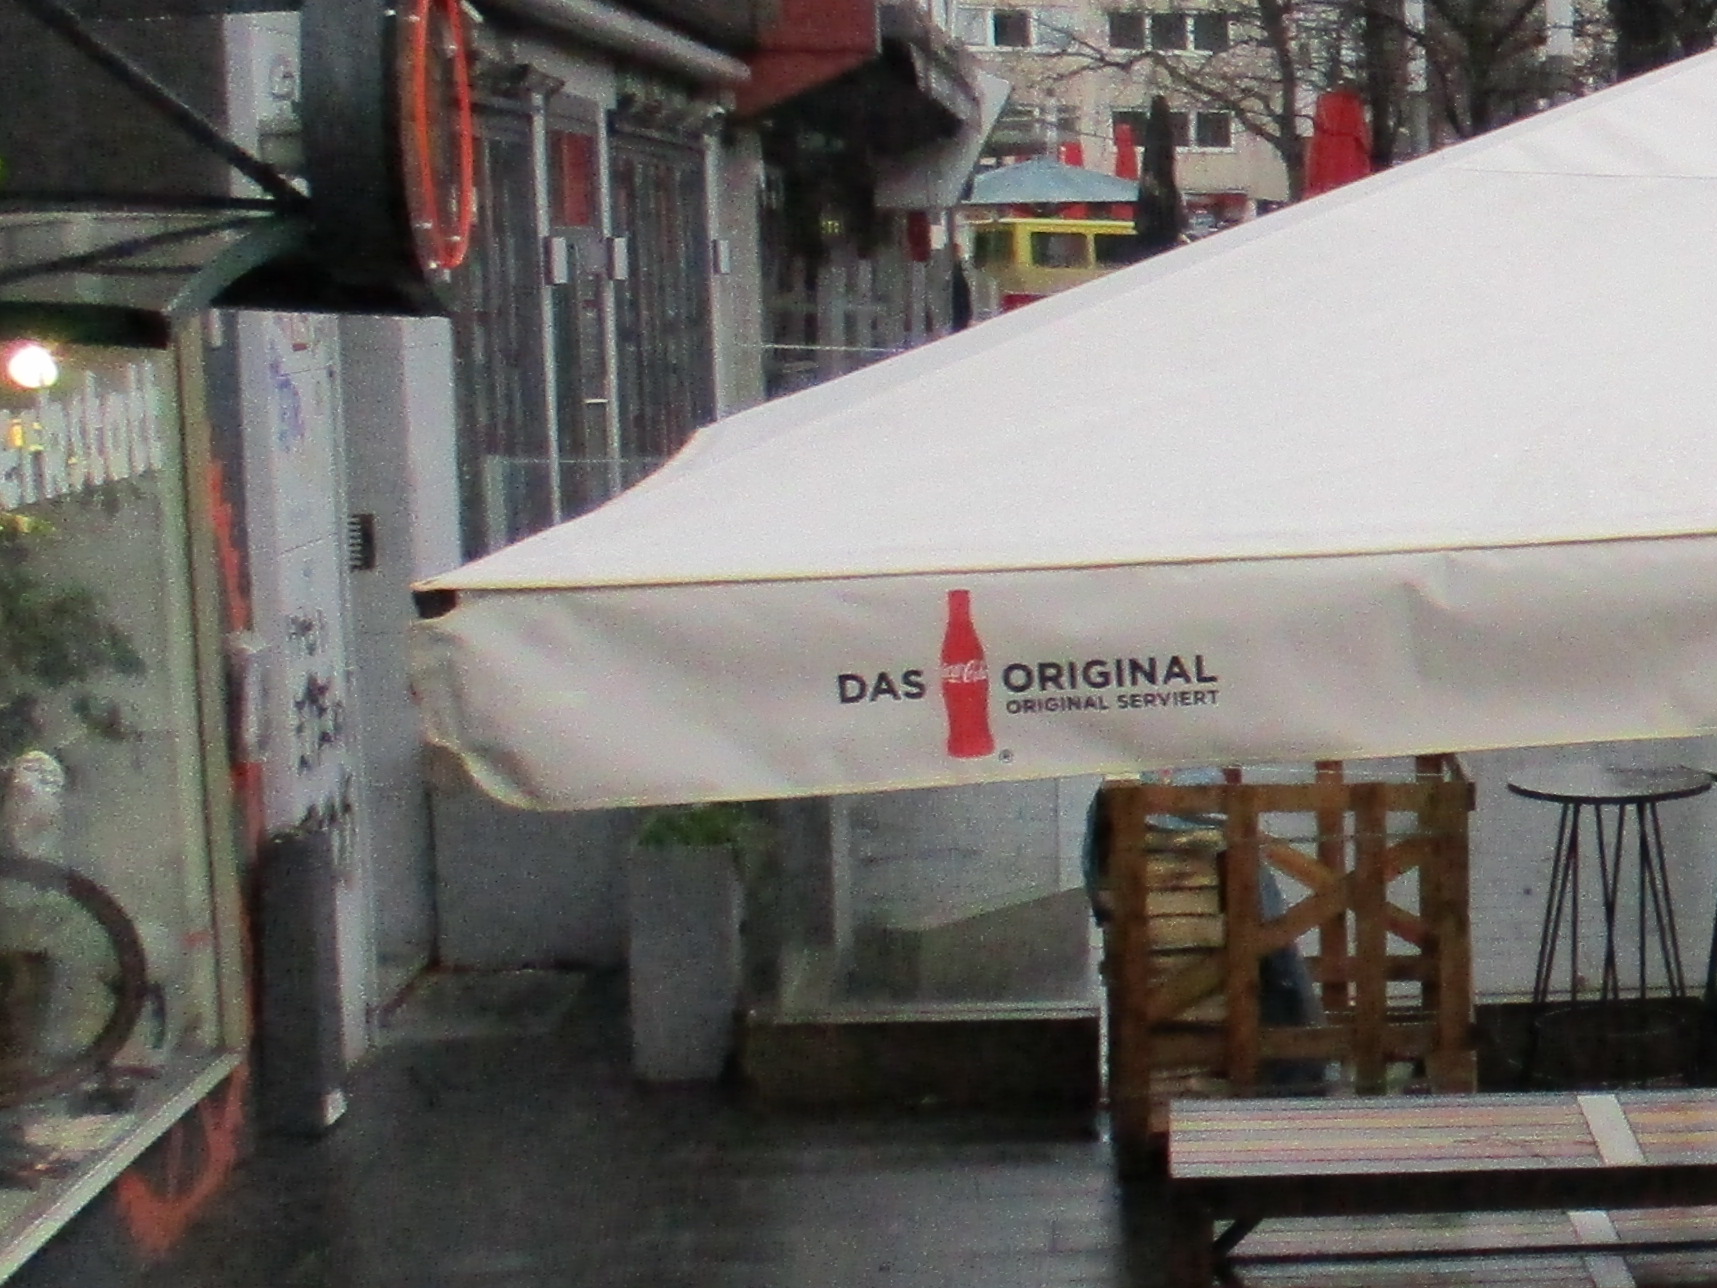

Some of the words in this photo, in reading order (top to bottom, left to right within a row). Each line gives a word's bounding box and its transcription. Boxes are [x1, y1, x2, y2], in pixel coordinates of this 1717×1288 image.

[838, 669, 927, 704] DAS
[1002, 654, 1219, 694] ORIGINAL
[1006, 694, 1109, 714] ORIGINAL
[1117, 689, 1220, 711] SERVIERT
